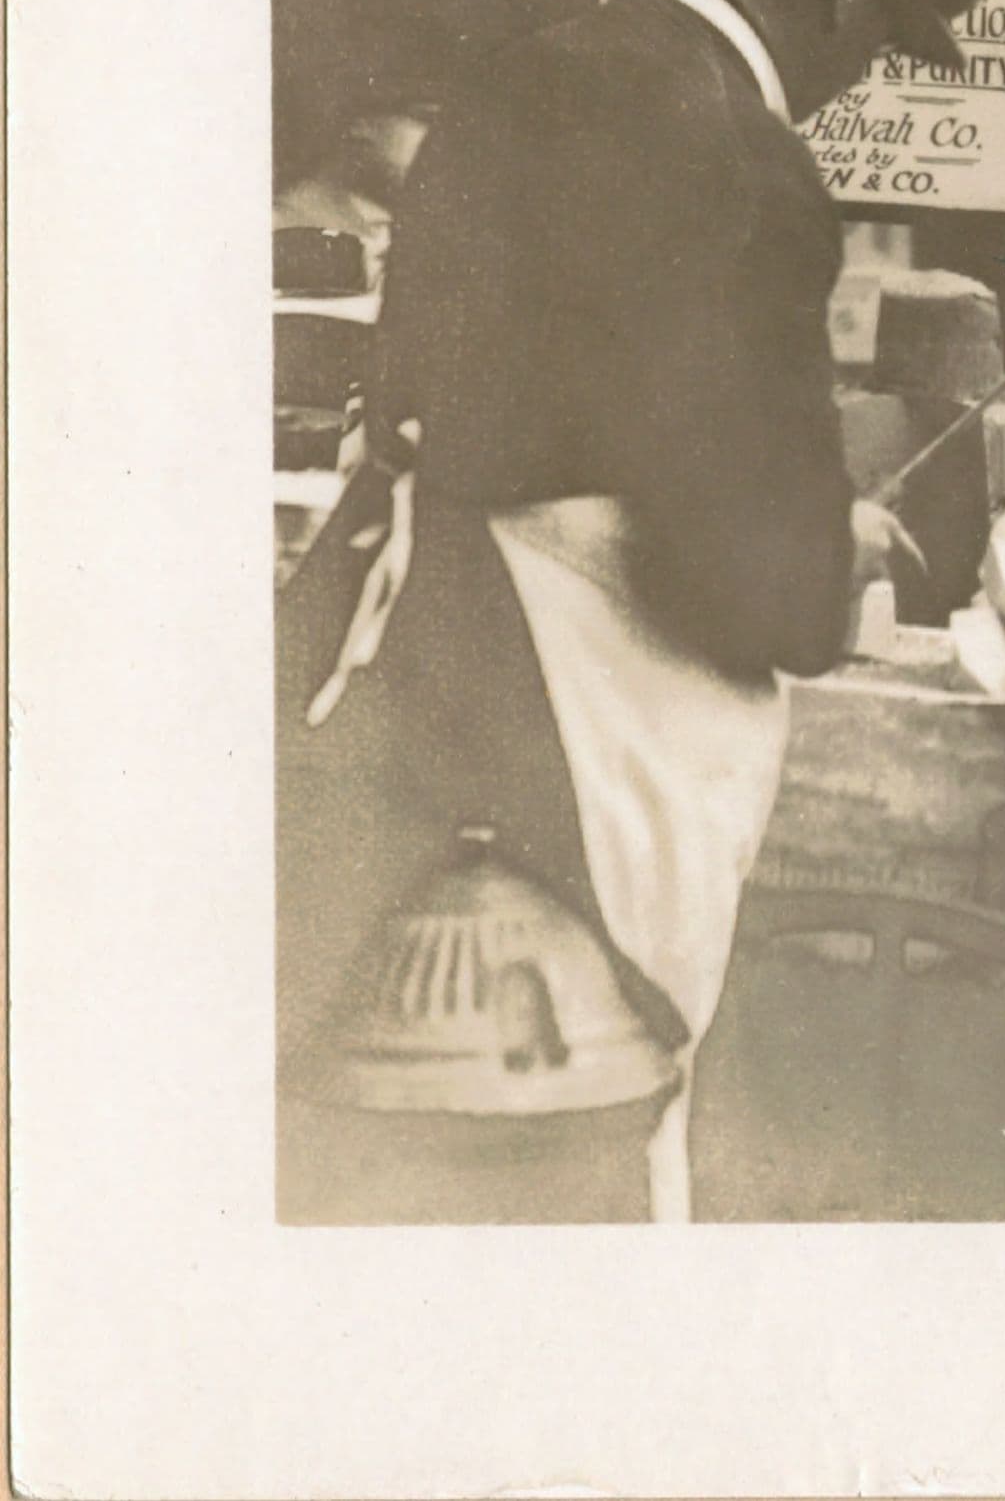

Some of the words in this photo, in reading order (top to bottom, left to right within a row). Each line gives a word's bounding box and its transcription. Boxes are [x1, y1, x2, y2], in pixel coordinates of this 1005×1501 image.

[802, 109, 915, 146] Halvah
[929, 117, 984, 150] Co.
[816, 145, 857, 164] ted
[866, 147, 898, 170] by
[861, 172, 882, 192] &
[891, 170, 940, 195] CO.
